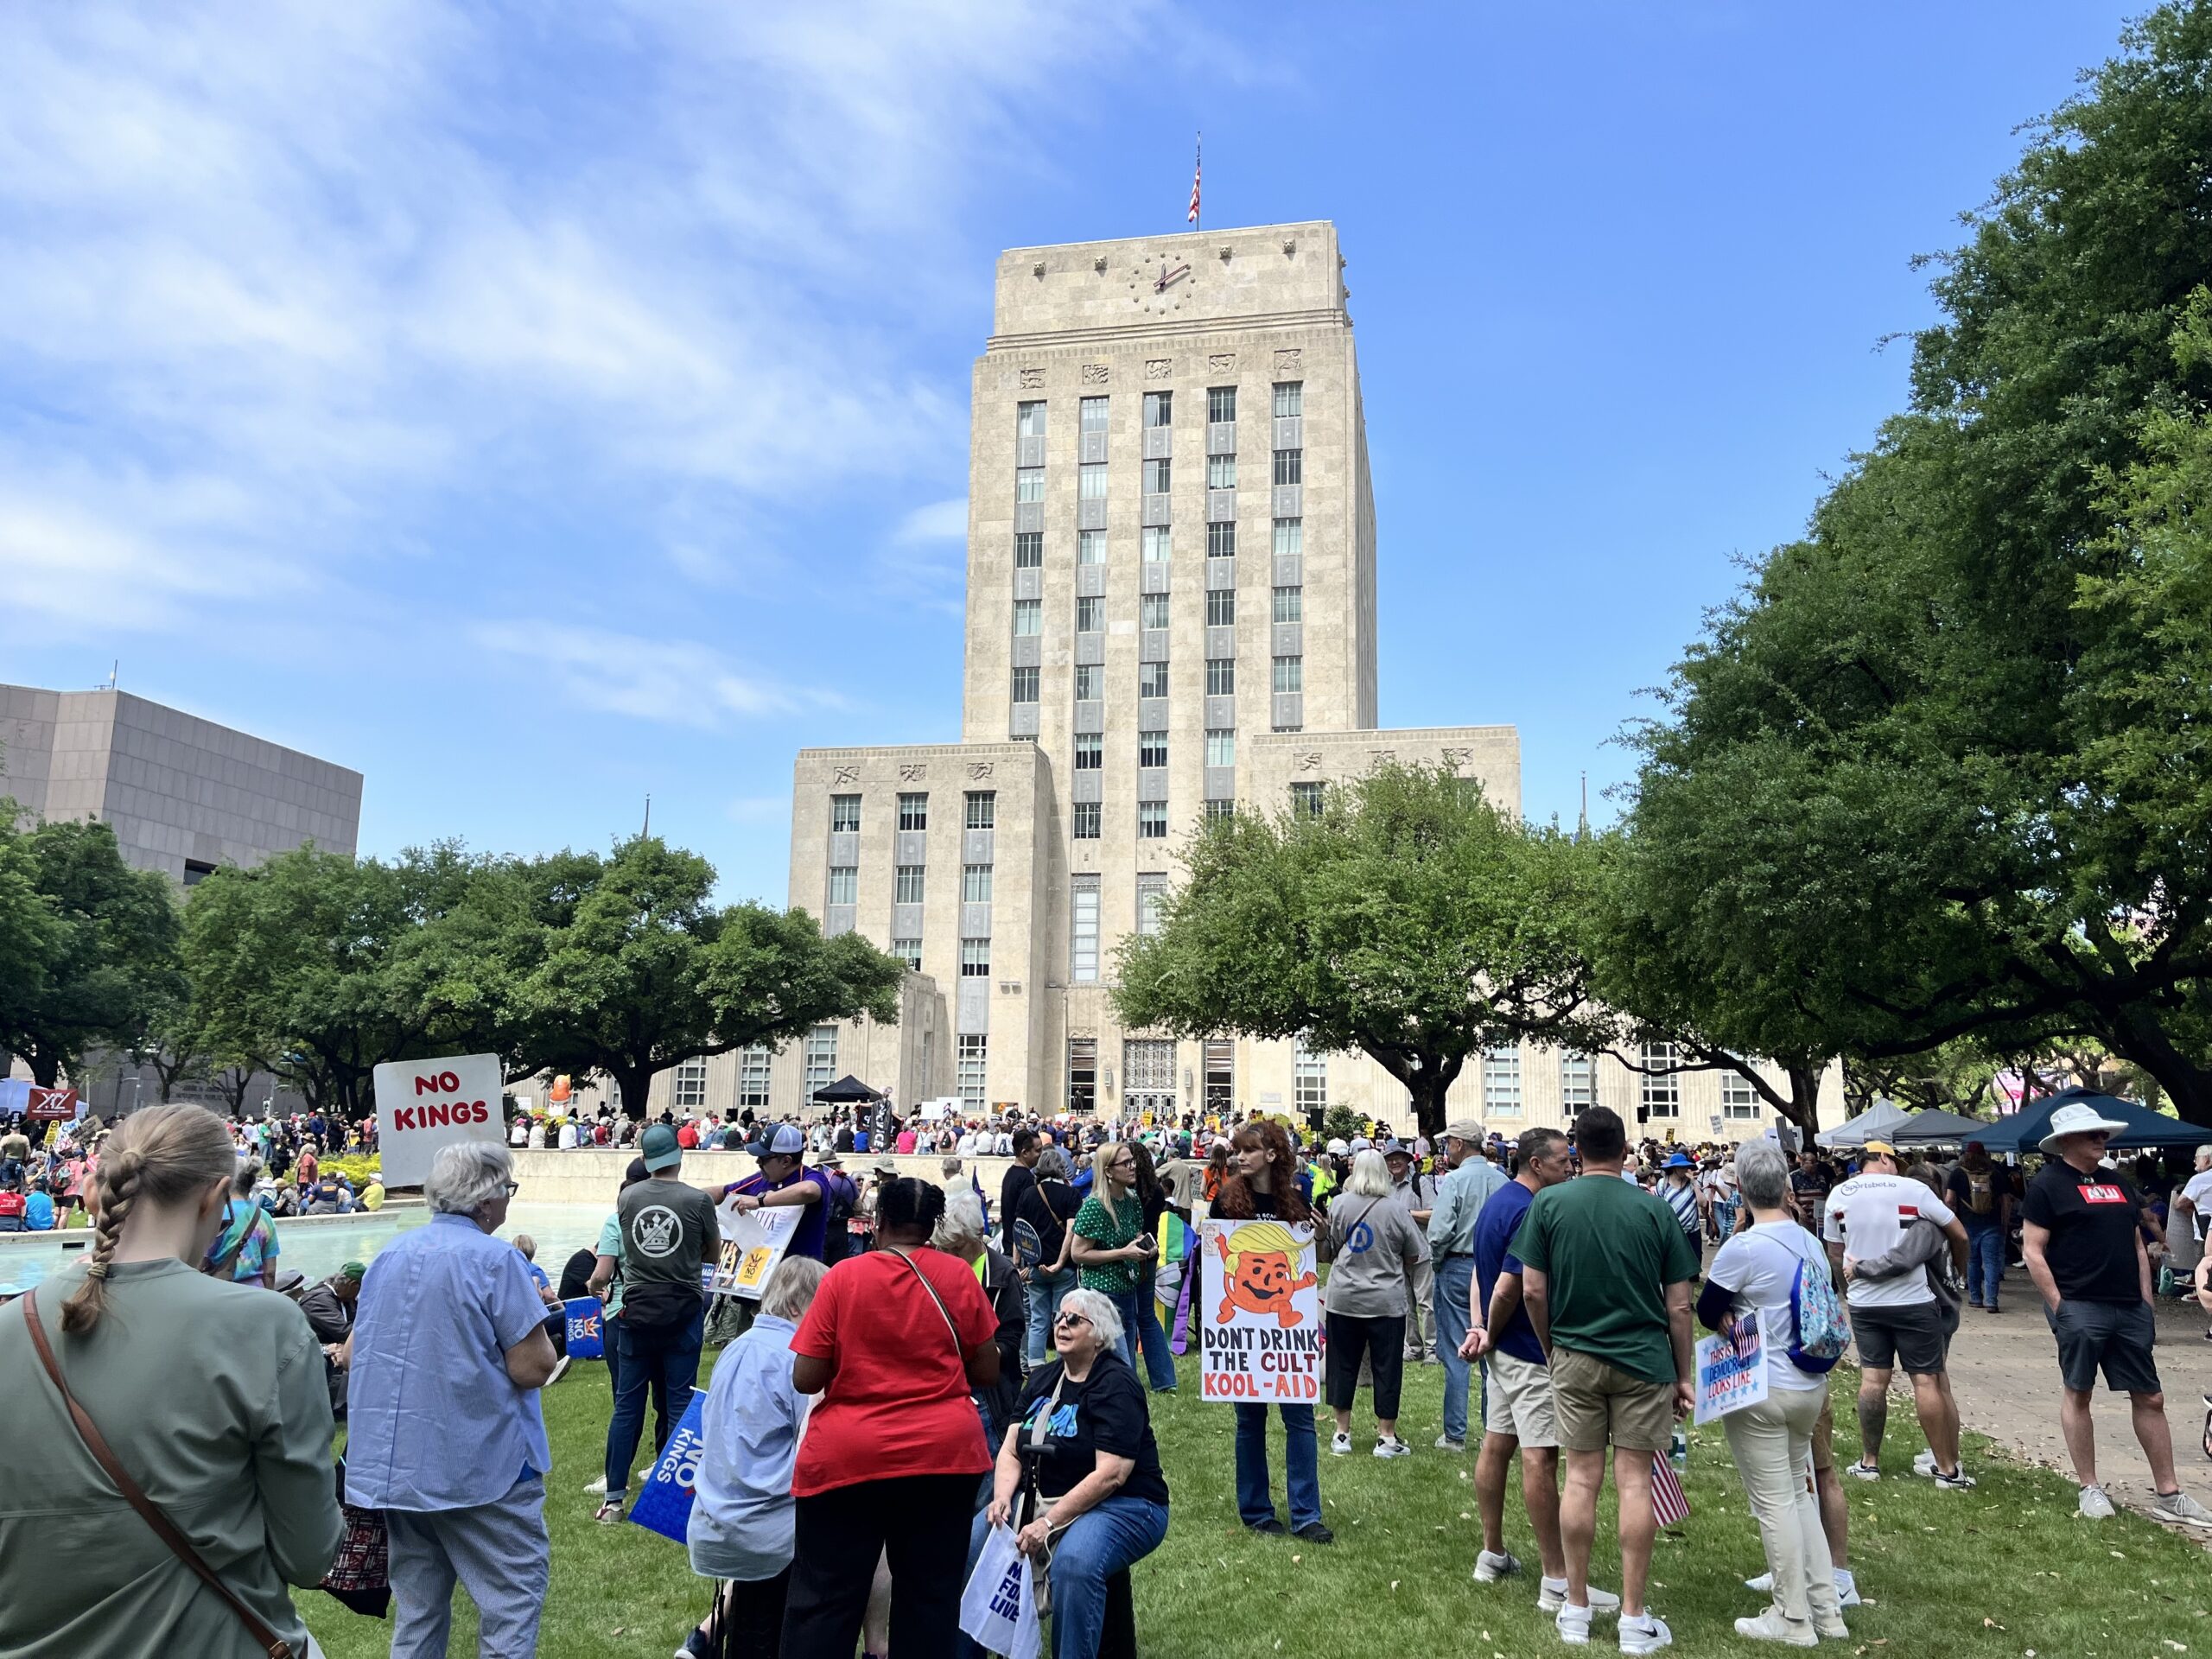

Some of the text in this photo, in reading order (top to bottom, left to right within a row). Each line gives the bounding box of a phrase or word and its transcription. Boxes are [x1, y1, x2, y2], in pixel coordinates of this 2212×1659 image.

[415, 1071, 460, 1096] NO
[394, 1100, 488, 1131] KINGS
[874, 1128, 885, 1147] ICE
[746, 1267, 756, 1275] NO
[574, 1319, 584, 1339] NO
[1205, 1327, 1319, 1351] DON'T DRINK
[1210, 1351, 1316, 1372] THE CULT
[1710, 1348, 1725, 1365] THIS
[1725, 1344, 1732, 1357] IS
[1708, 1369, 1751, 1398] LOOKS LIKE
[657, 1427, 694, 1484] KINGS
[675, 1437, 704, 1488] NO
